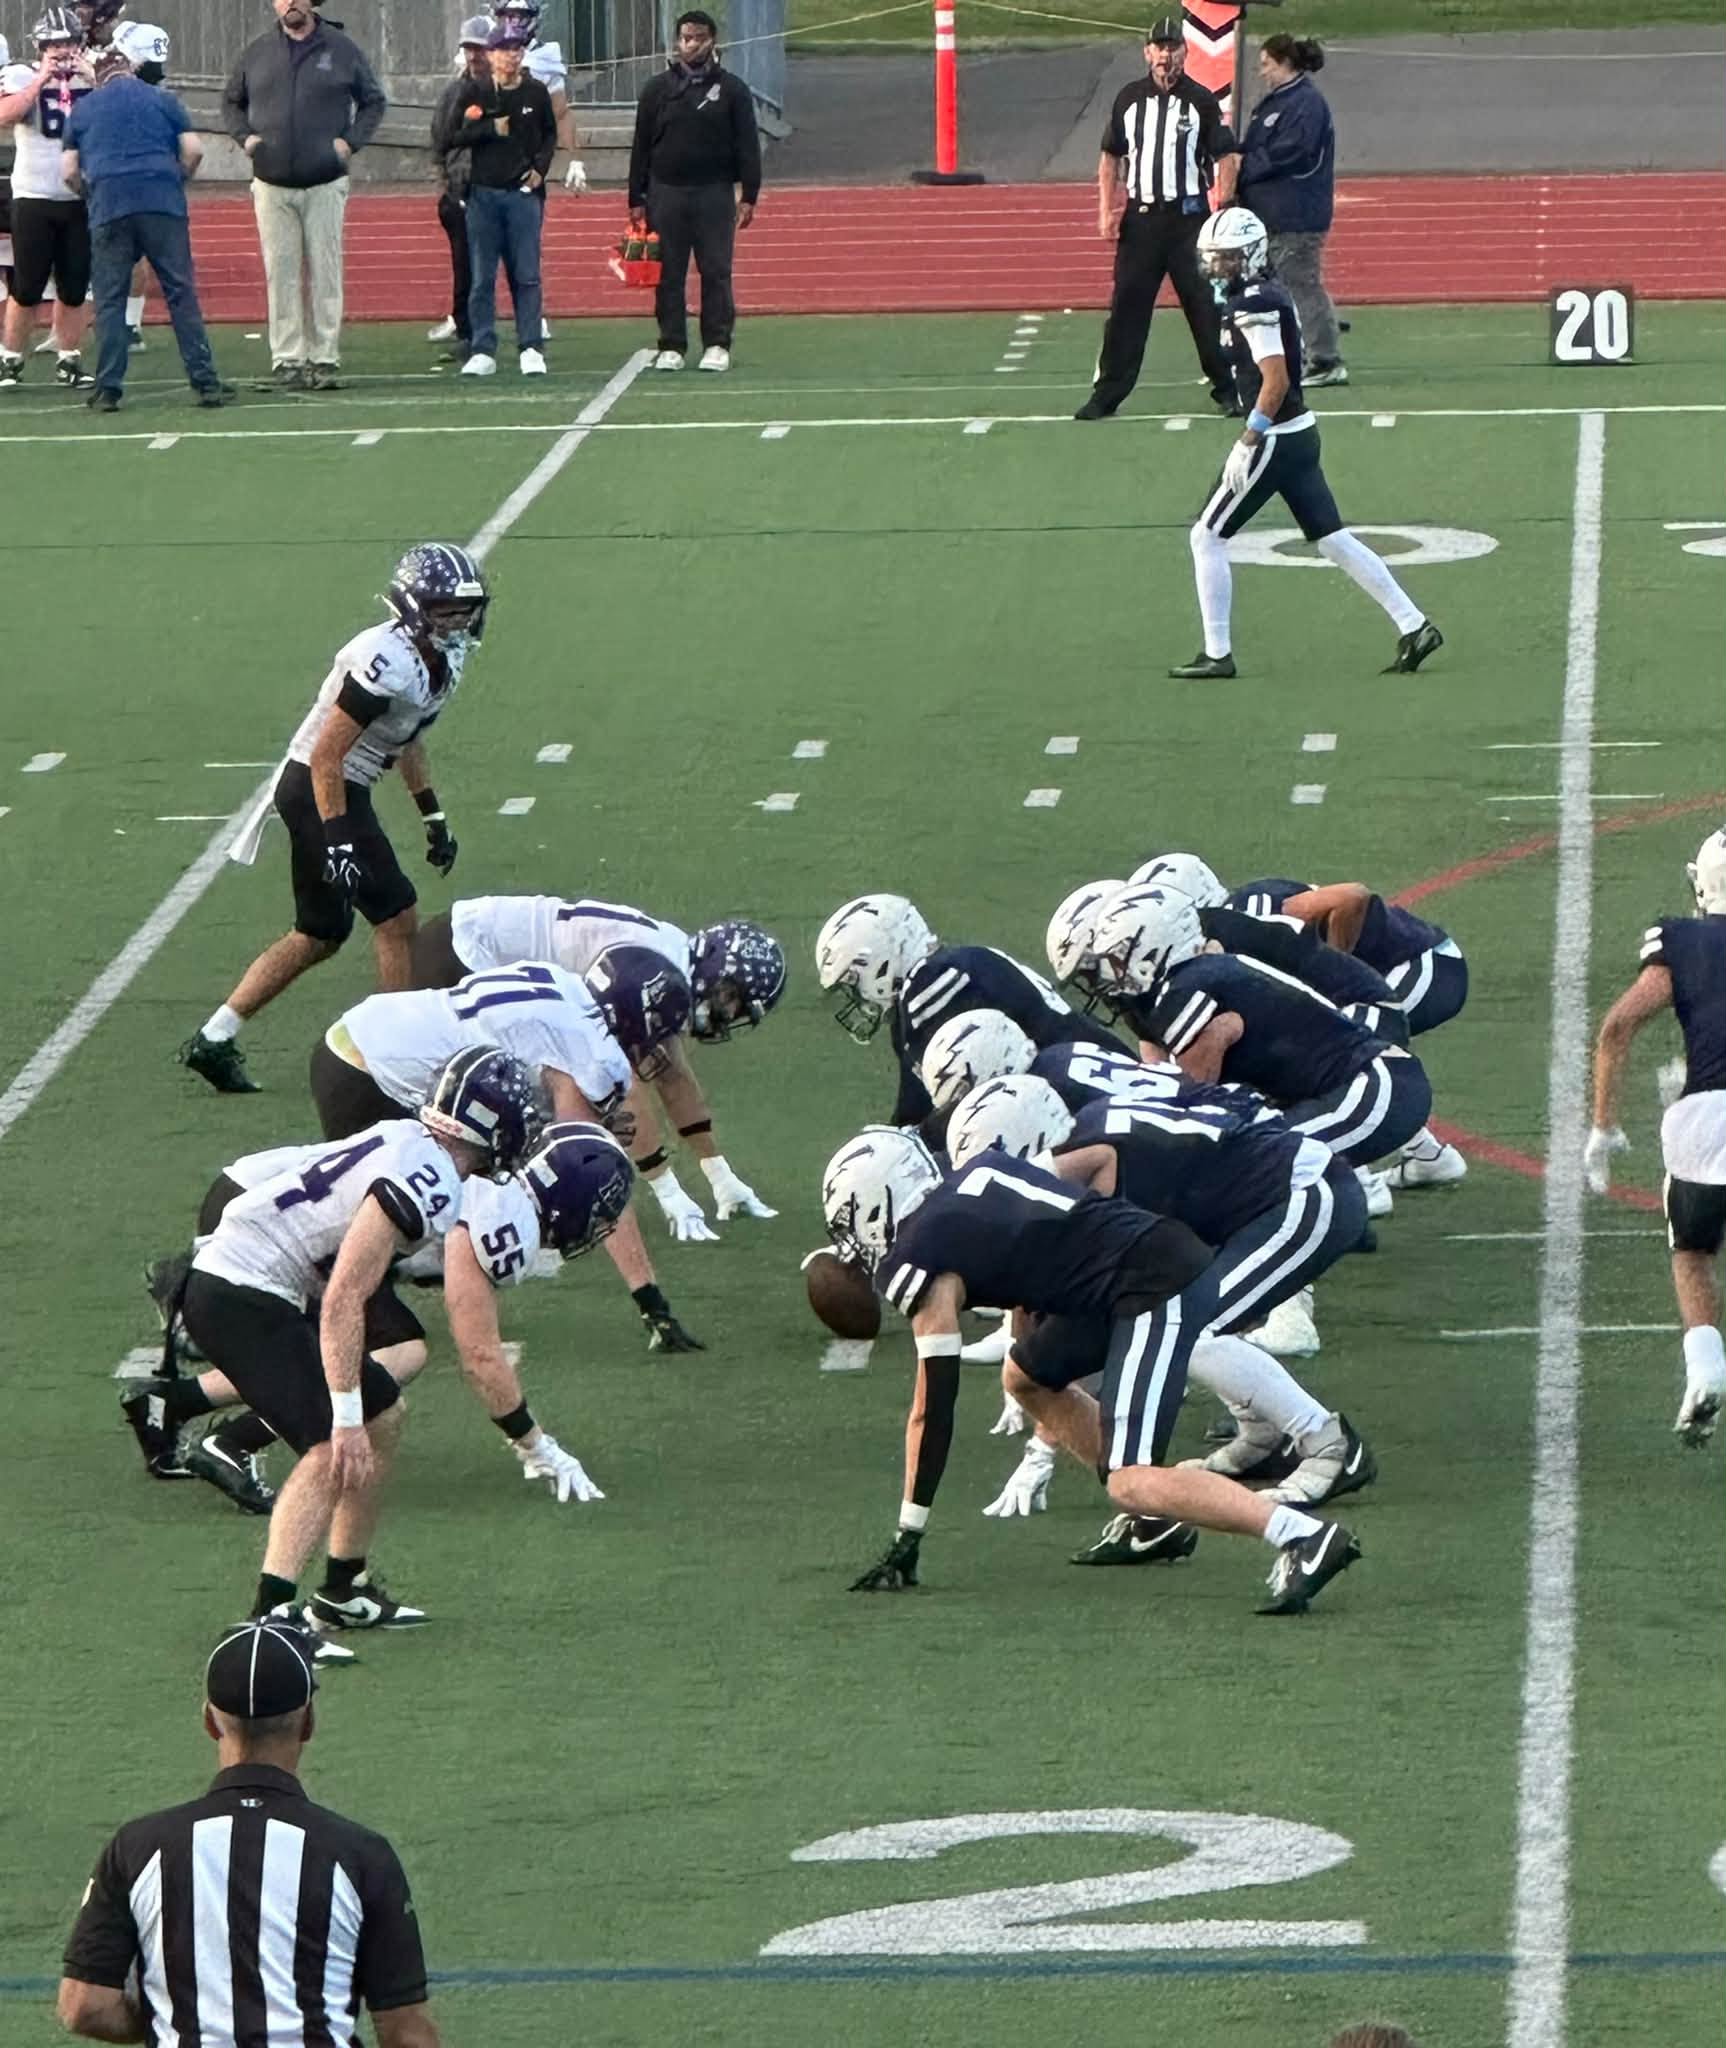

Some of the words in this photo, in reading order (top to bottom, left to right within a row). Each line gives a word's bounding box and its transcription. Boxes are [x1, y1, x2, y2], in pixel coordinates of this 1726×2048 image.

[1555, 289, 1629, 360] 20
[1226, 525, 1500, 567] 0
[364, 653, 391, 683] 5
[1104, 1095, 1228, 1142] 7
[406, 1163, 452, 1219] 24
[956, 1165, 1078, 1213] 7
[480, 1222, 526, 1281] 55
[759, 1808, 1369, 1957] 2
